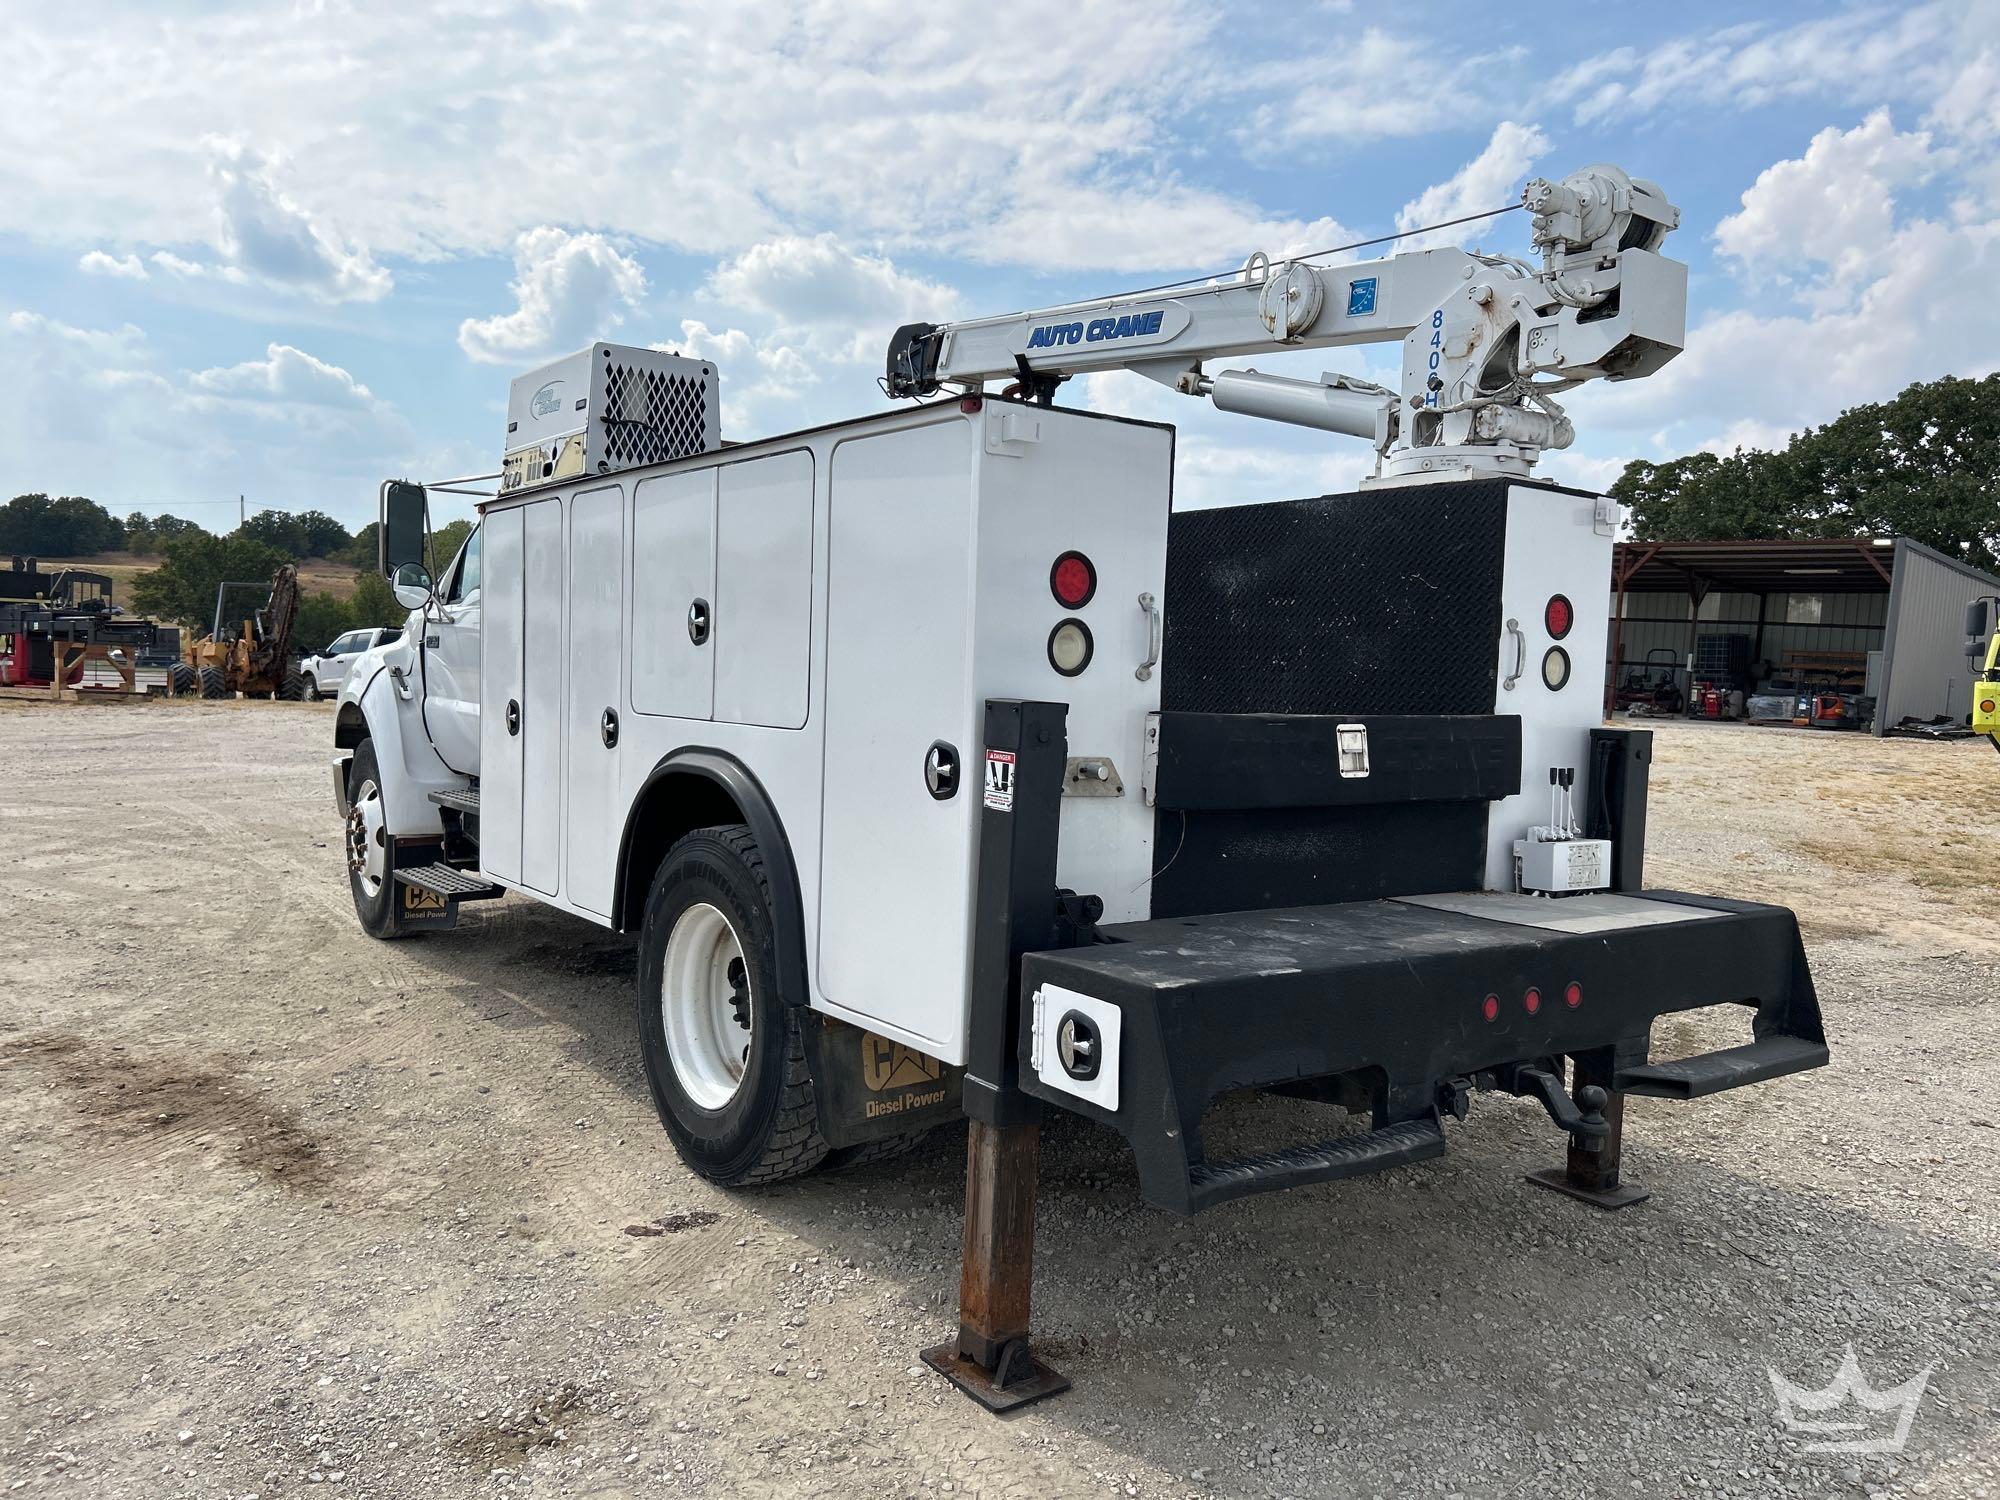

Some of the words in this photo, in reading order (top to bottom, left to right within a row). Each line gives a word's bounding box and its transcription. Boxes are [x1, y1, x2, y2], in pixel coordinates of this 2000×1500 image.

[1026, 322, 1084, 349] AUTO
[1086, 310, 1165, 342] CRANE
[993, 753, 1011, 762] DANGER
[404, 911, 426, 919] Diesel
[427, 910, 447, 918] Power
[866, 1095, 903, 1118] Diesel
[905, 1090, 946, 1110] Power
